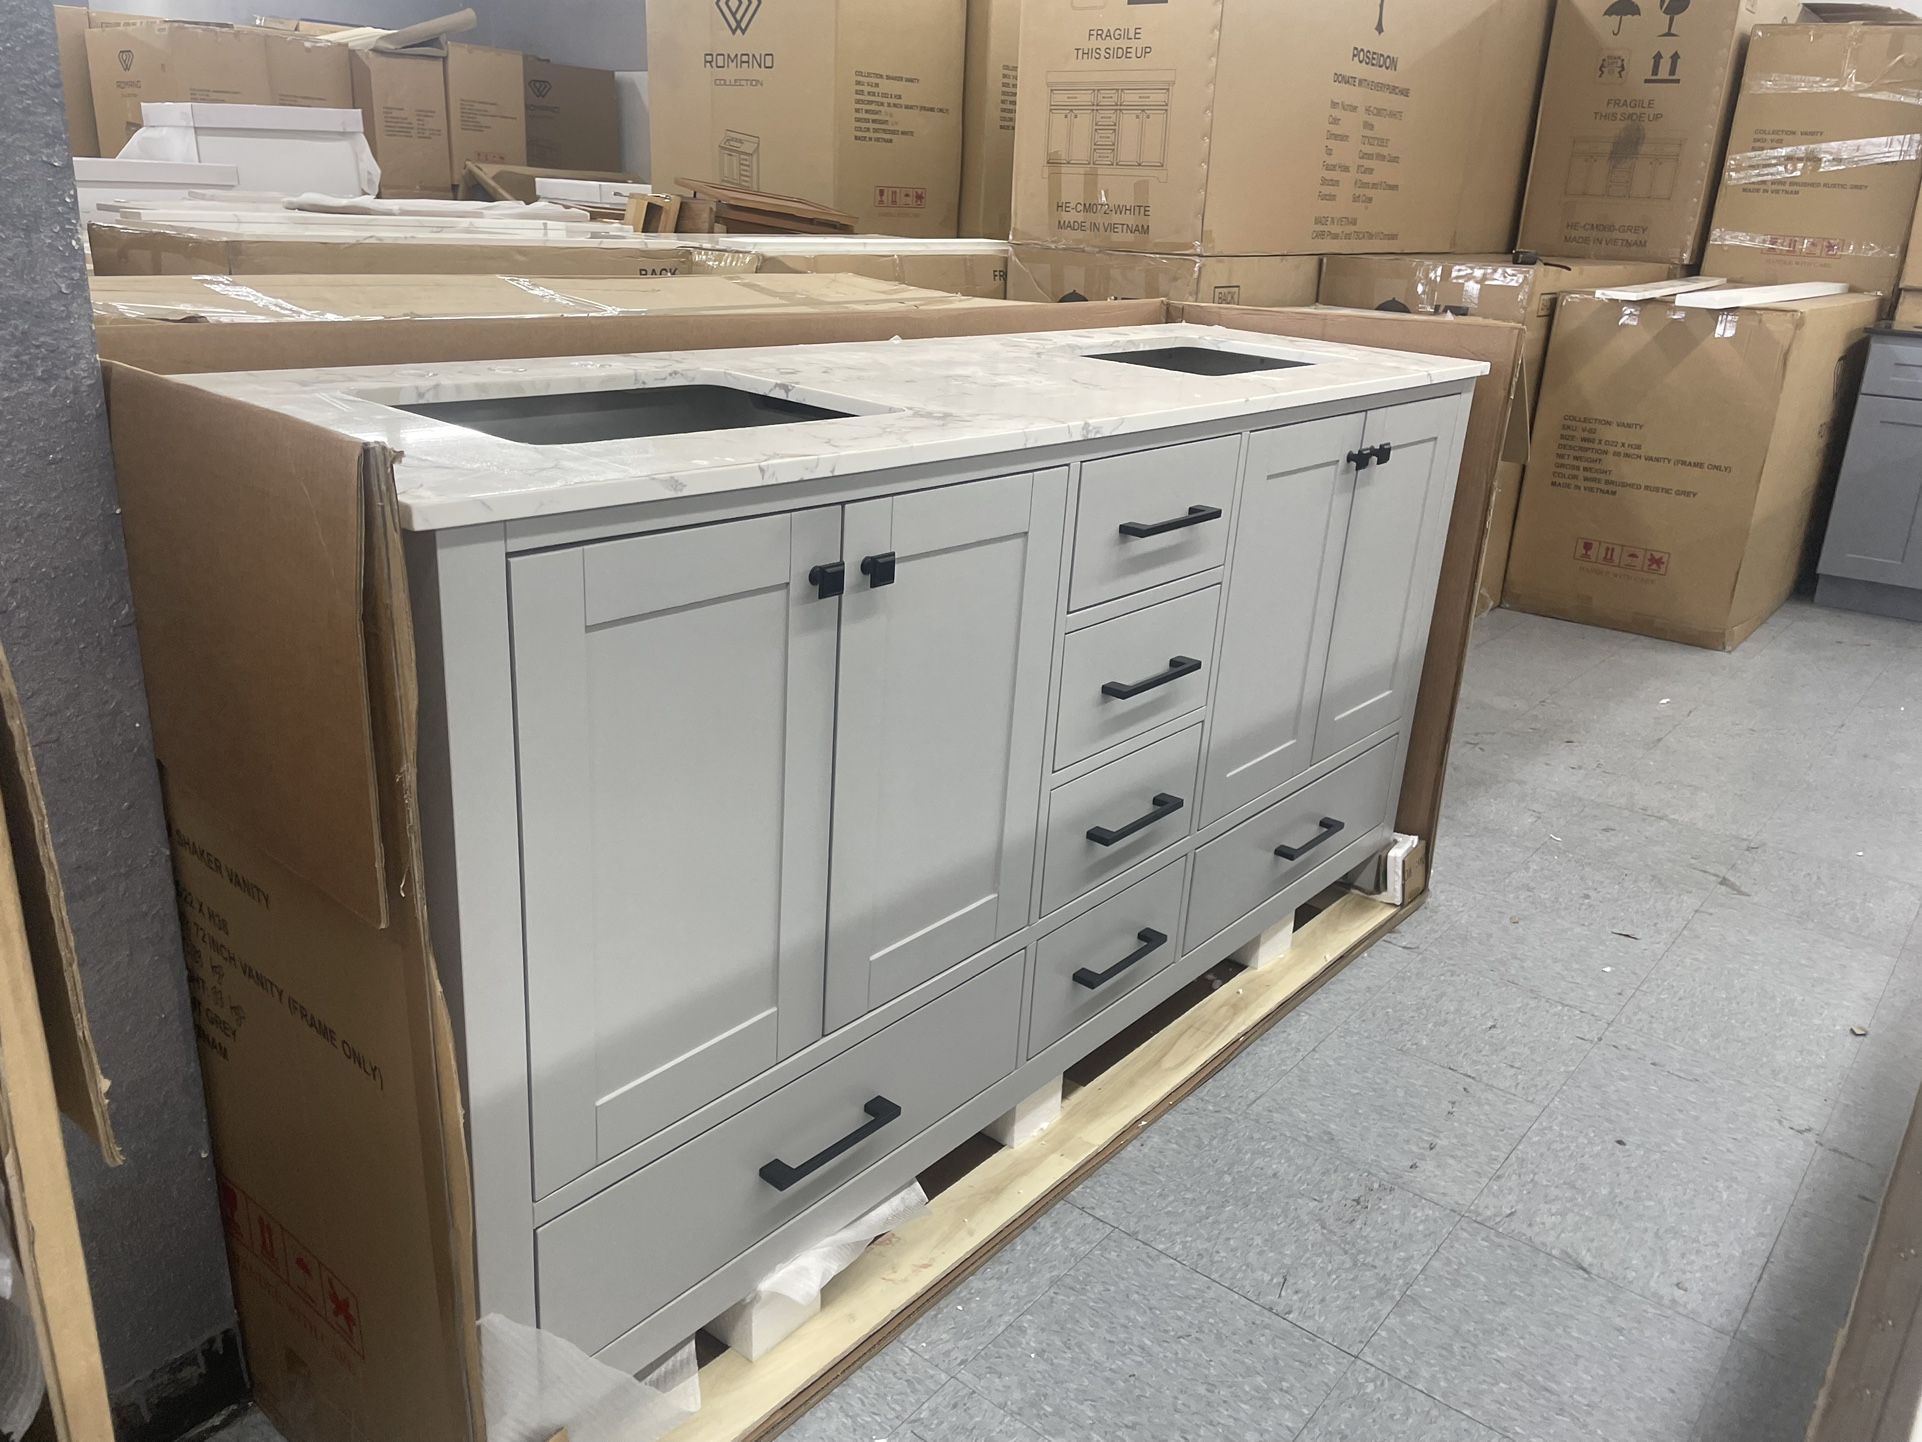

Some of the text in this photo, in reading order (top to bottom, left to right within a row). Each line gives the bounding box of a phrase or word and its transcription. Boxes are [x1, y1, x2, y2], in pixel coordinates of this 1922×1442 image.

[1088, 27, 1142, 41] FRAGILE
[1074, 46, 1152, 60] THIS SIDE UP
[1352, 46, 1398, 72] POSEIDON
[704, 53, 774, 69] ROMANO
[714, 78, 763, 87] COLLECTION
[1333, 72, 1357, 87] DONATE
[1606, 99, 1656, 110] FRAGILE
[1594, 112, 1663, 122] THIS SIDE UP
[1056, 201, 1151, 216] HE-CM072-WHITE
[1057, 220, 1150, 235] MADE IN VIETNAM
[1563, 235, 1648, 248] MADE IN VIETNAM
[1556, 452, 1570, 460] NET
[1623, 451, 1642, 460] INCH
[1644, 454, 1672, 464] VANITY
[1673, 458, 1705, 470] (FRAME
[1706, 463, 1732, 473] ONLY)
[1554, 462, 1580, 471] GROSS
[1551, 480, 1572, 490] MADE
[1584, 486, 1617, 496] VIETNAM
[1583, 476, 1602, 484] WIRE
[1604, 479, 1642, 490] BRUSHED
[1644, 484, 1673, 495] RUSTIC
[1674, 489, 1698, 498] GREY
[175, 829, 270, 912] SHAKER VANITY
[209, 942, 237, 969] INCH
[238, 960, 284, 1004] VANITY
[288, 994, 337, 1049] (FRAME
[341, 1040, 383, 1090] ONLY)
[206, 1006, 238, 1043] GREY
